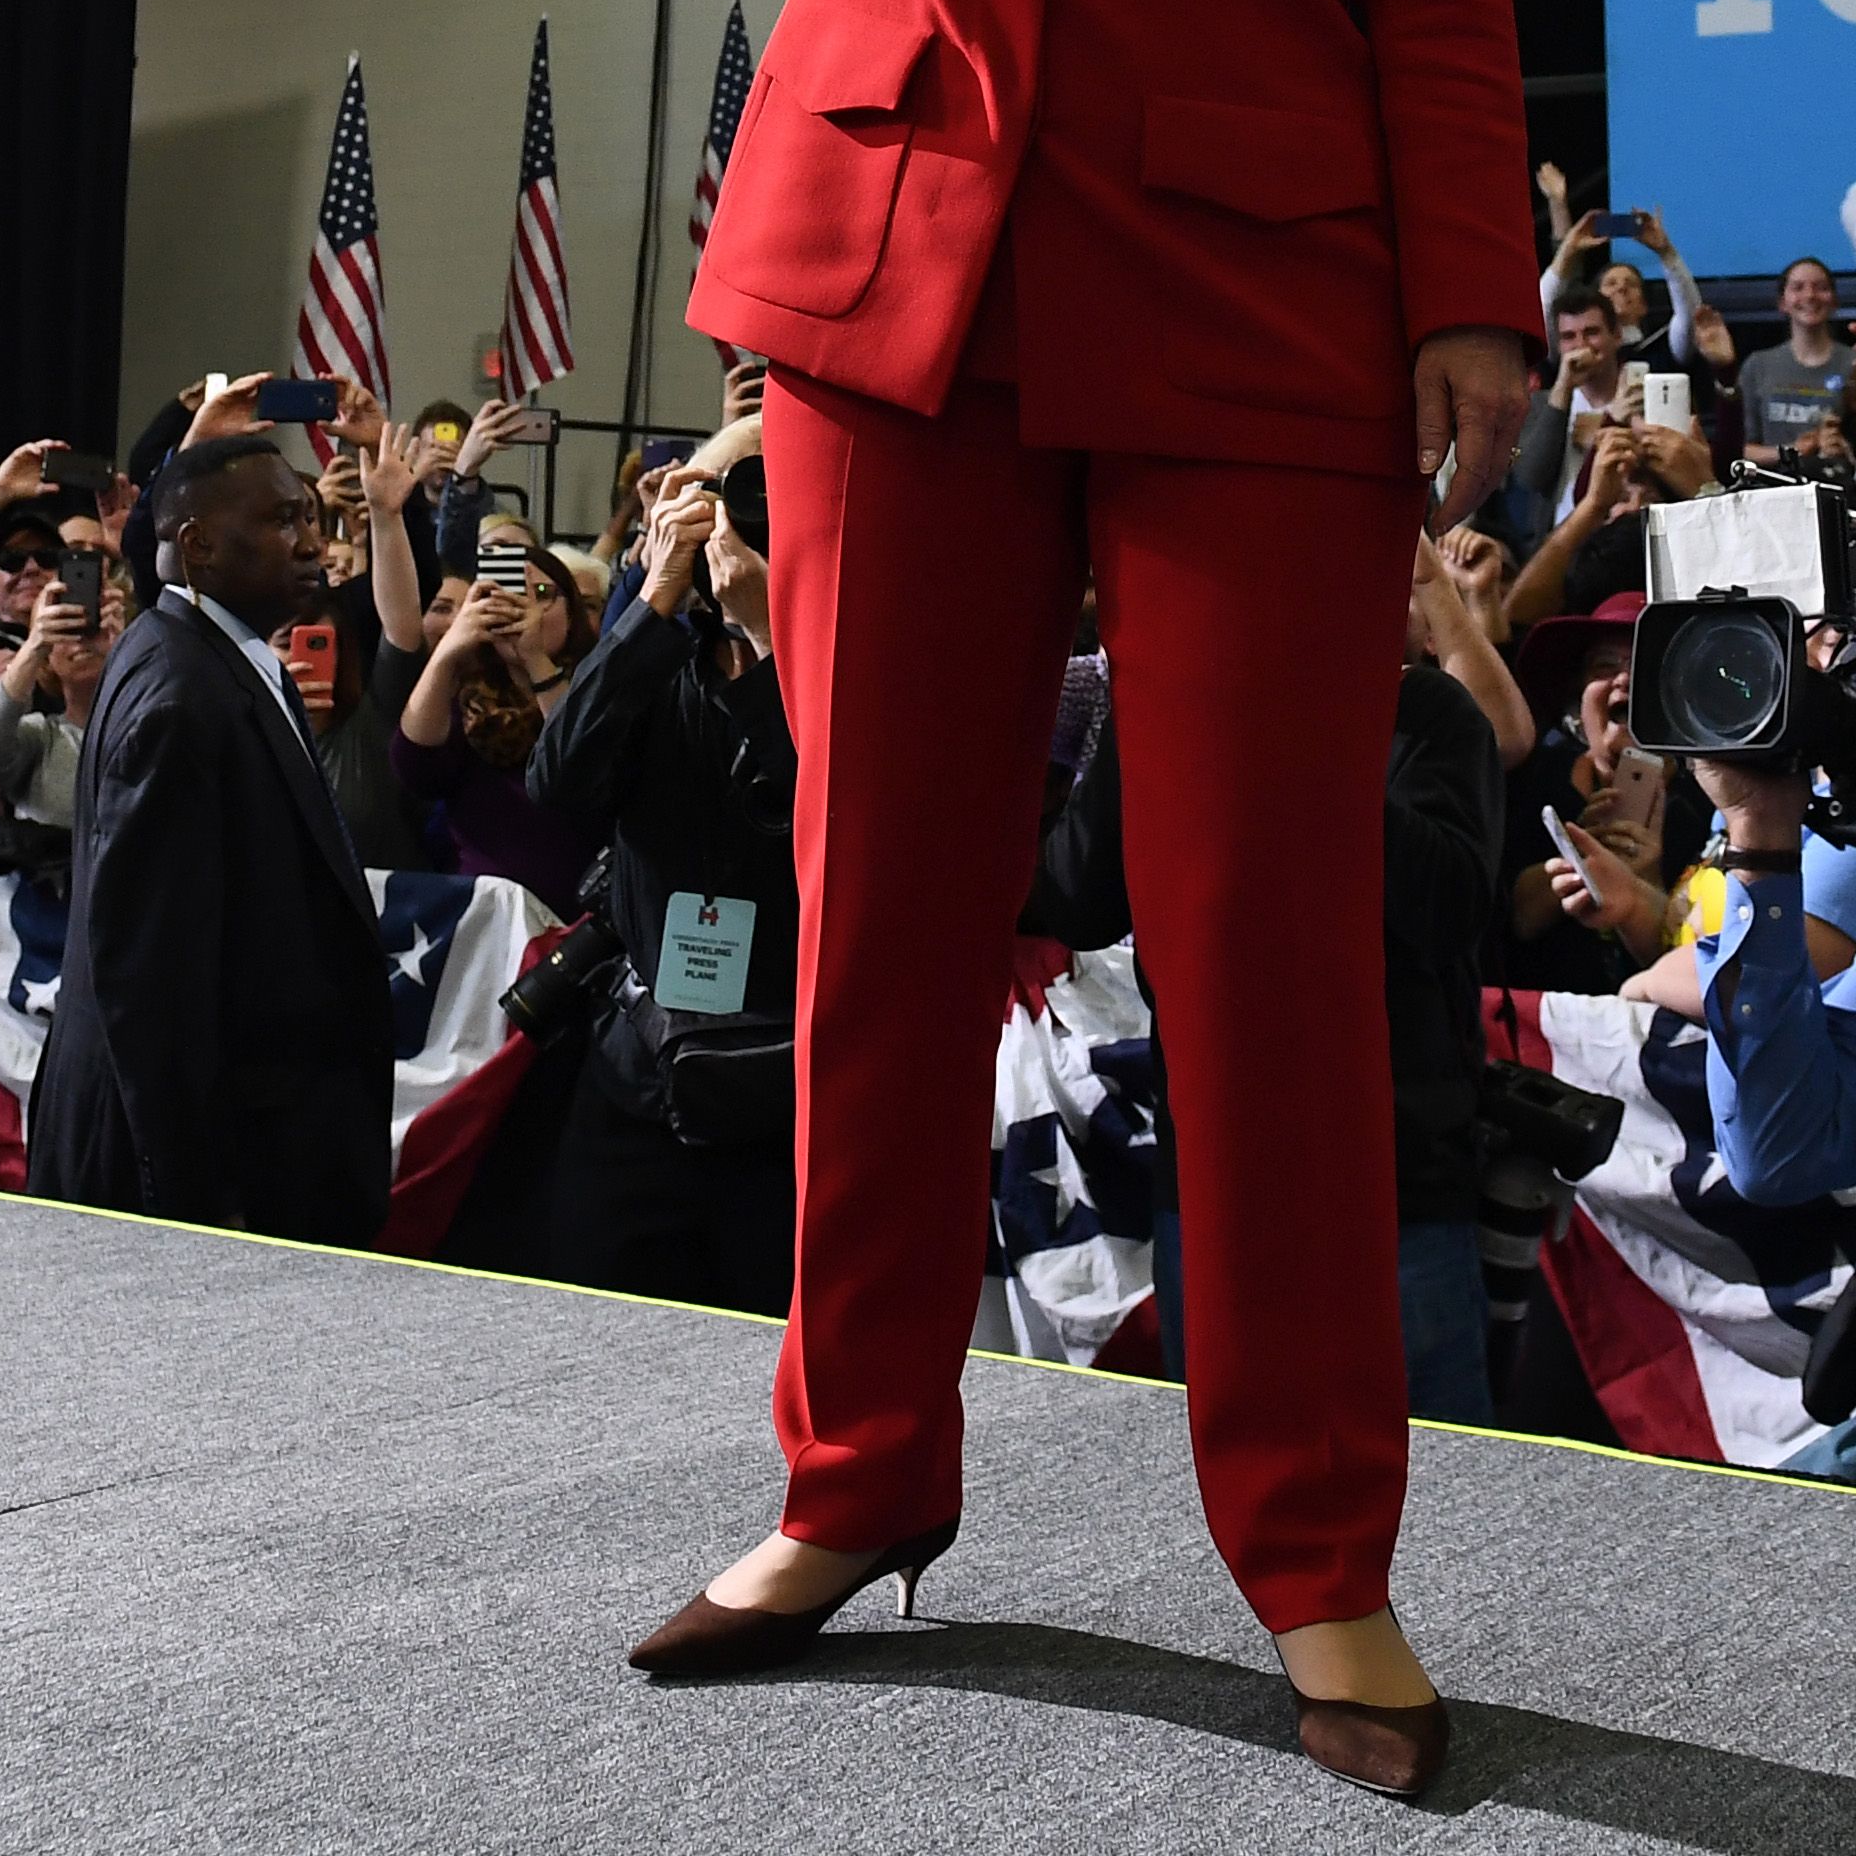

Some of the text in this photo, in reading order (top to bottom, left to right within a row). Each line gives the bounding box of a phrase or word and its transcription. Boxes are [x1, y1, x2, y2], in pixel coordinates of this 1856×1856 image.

[677, 942, 732, 957] TRAVELING
[687, 956, 719, 969] PRESS
[684, 969, 717, 981] PLANE
